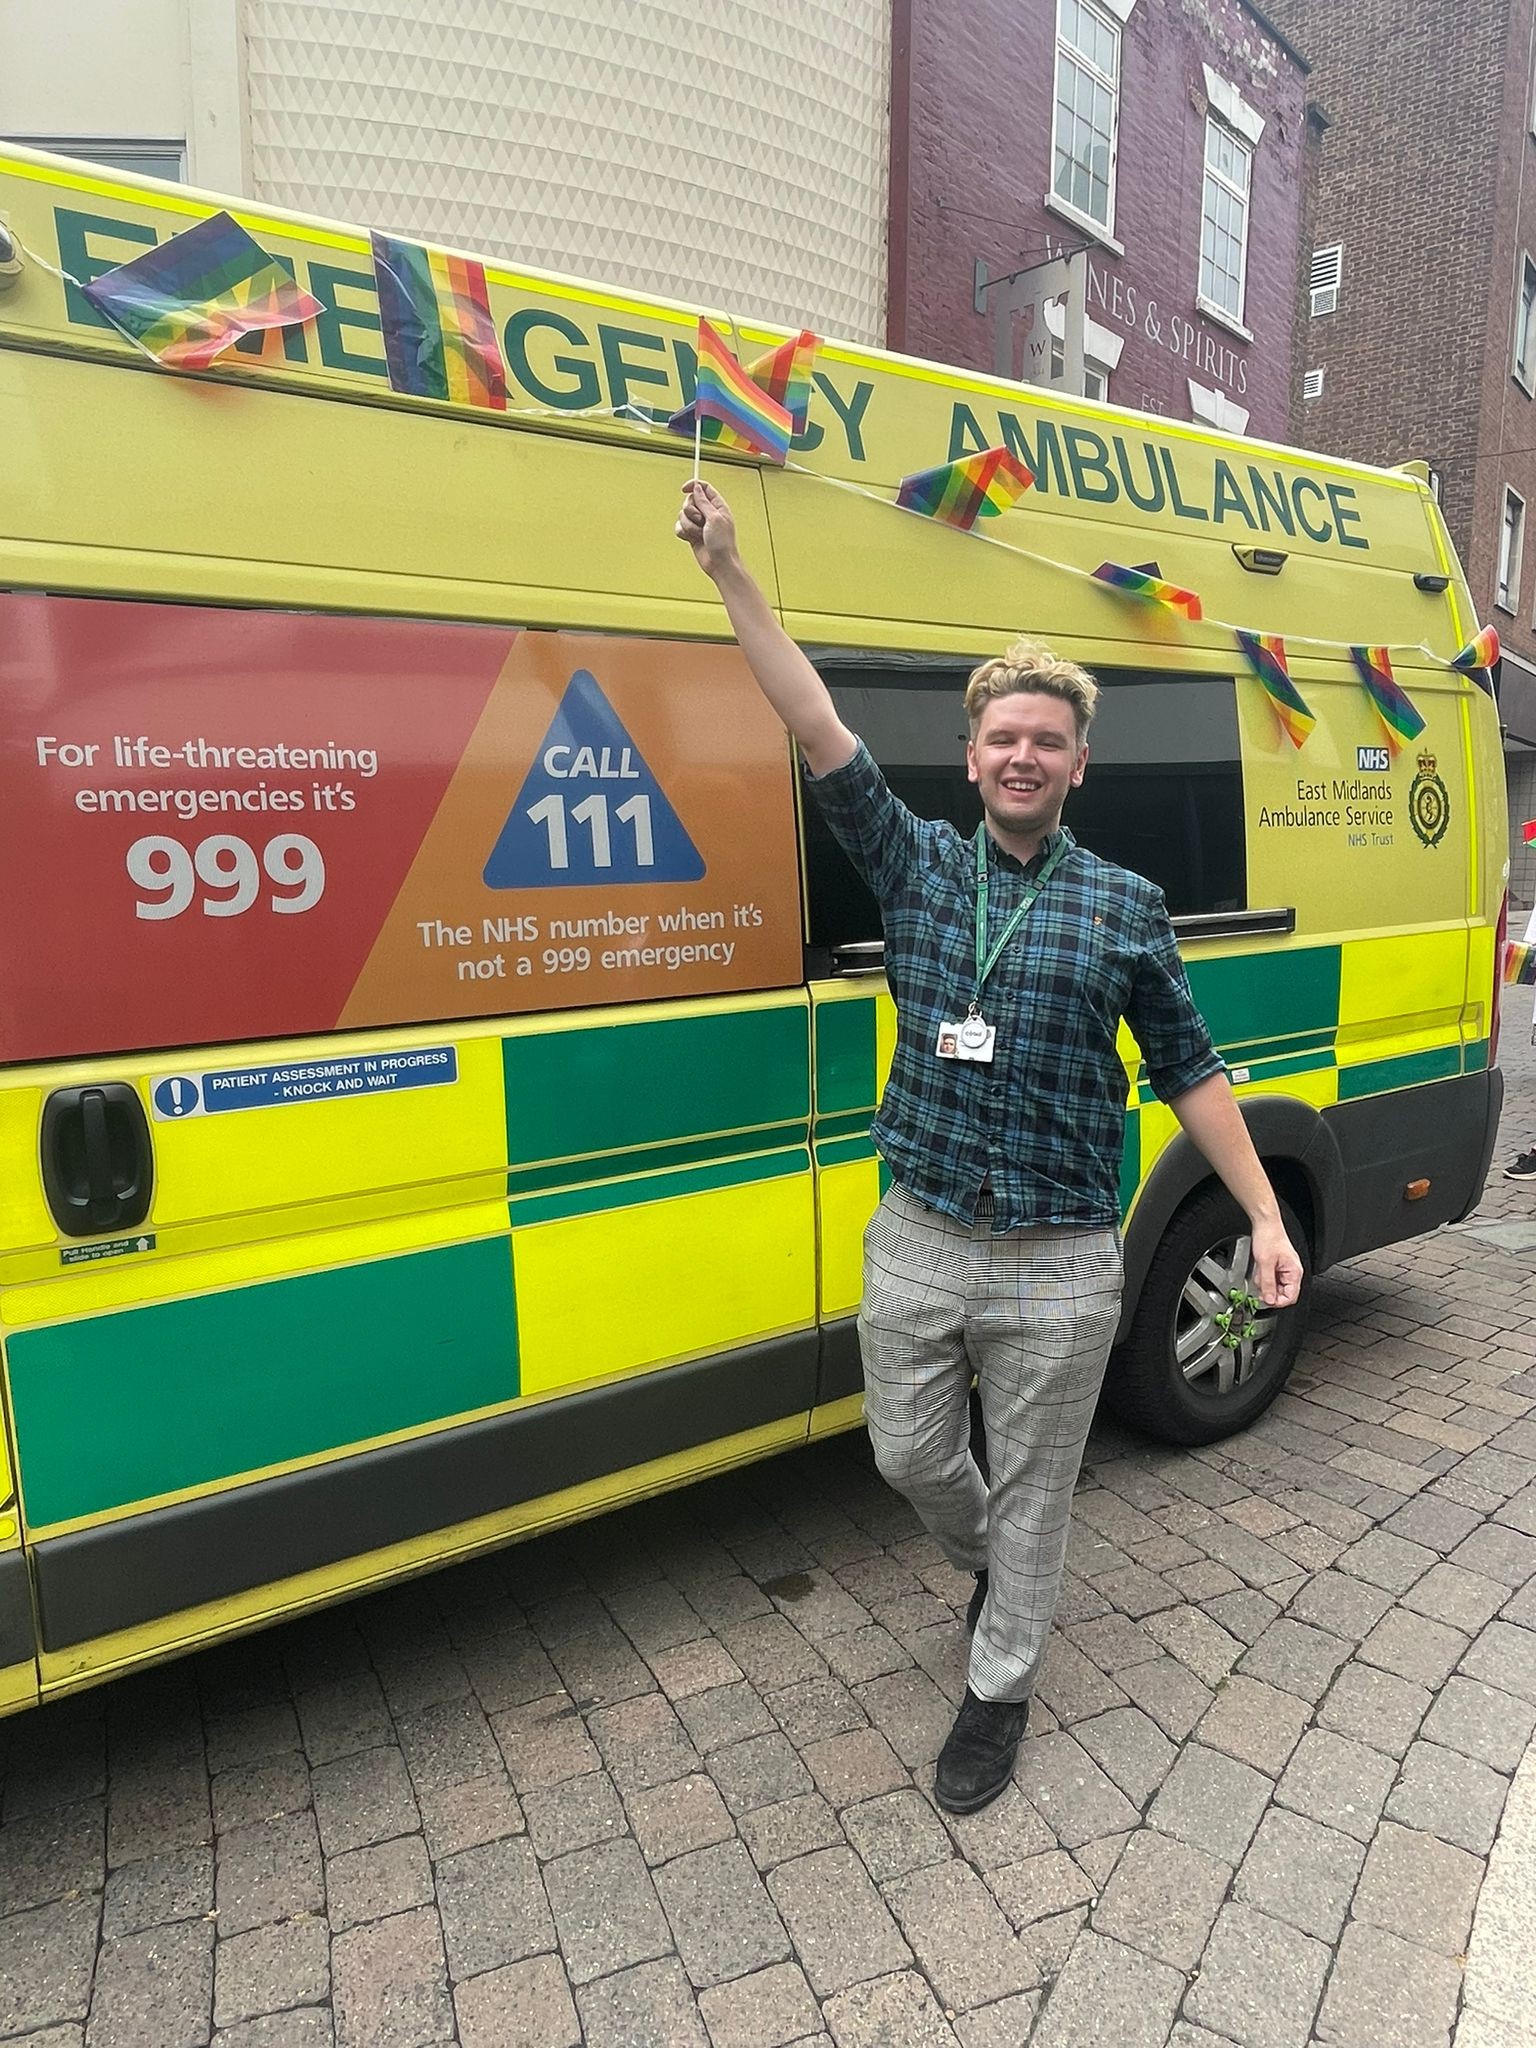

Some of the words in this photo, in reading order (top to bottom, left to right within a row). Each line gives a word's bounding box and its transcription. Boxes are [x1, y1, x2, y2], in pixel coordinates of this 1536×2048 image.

[1030, 339, 1047, 357] W
[1144, 301, 1163, 346] &
[1169, 315, 1248, 394] SPIRITS
[948, 402, 1369, 550] AMBULANCE
[35, 736, 100, 768] For
[113, 736, 379, 777] life-threatening
[543, 745, 640, 779] CALL
[1358, 748, 1389, 770] NHS
[75, 782, 305, 820] emergencies
[312, 782, 357, 812] it's
[1297, 780, 1327, 801] East
[1332, 779, 1392, 801] Midlands
[526, 794, 655, 869] 111
[1259, 805, 1340, 828] Ambulance
[1345, 805, 1393, 826] Service
[1348, 834, 1367, 847] NHS
[1371, 832, 1393, 846] Trust
[126, 832, 325, 920] 999
[417, 919, 472, 948] The
[482, 915, 539, 945] NHS
[549, 910, 649, 941] number
[657, 906, 725, 933] when
[733, 902, 763, 929] it's
[458, 954, 506, 981] not
[516, 957, 532, 977] a
[542, 946, 591, 974] 999
[601, 942, 736, 970] emergency
[212, 1073, 268, 1090] PATIENT
[272, 1062, 360, 1083] ASSESSMENT
[364, 1060, 377, 1072] IN
[381, 1052, 448, 1069] PROGRESS
[283, 1081, 332, 1098] KNOCK
[336, 1077, 363, 1092] AND
[367, 1073, 398, 1087] WAIT
[102, 1248, 124, 1256] open
[113, 1240, 129, 1249] and
